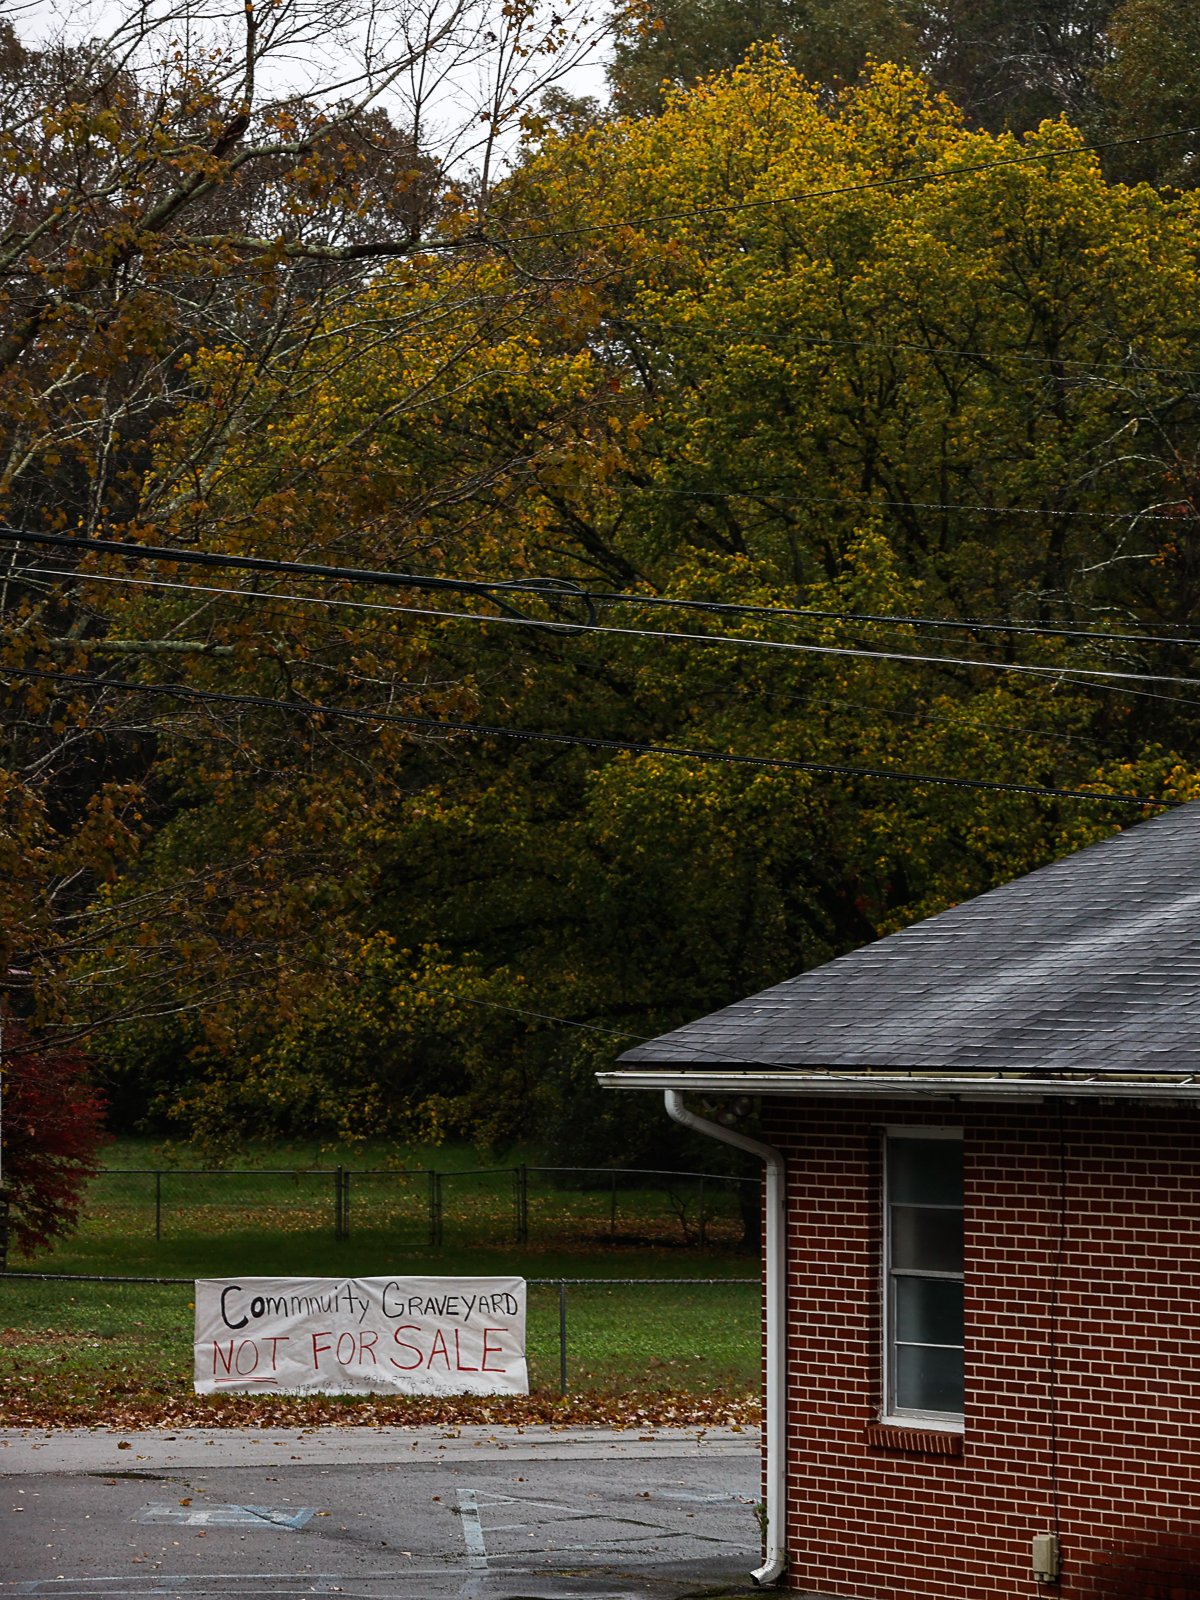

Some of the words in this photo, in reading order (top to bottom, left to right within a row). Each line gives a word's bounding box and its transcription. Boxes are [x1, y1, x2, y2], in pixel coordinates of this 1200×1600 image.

[382, 1281, 519, 1323] GRAVEYARD
[213, 1336, 290, 1376] NOT
[312, 1330, 379, 1370] FOR
[389, 1324, 509, 1373] SALE
